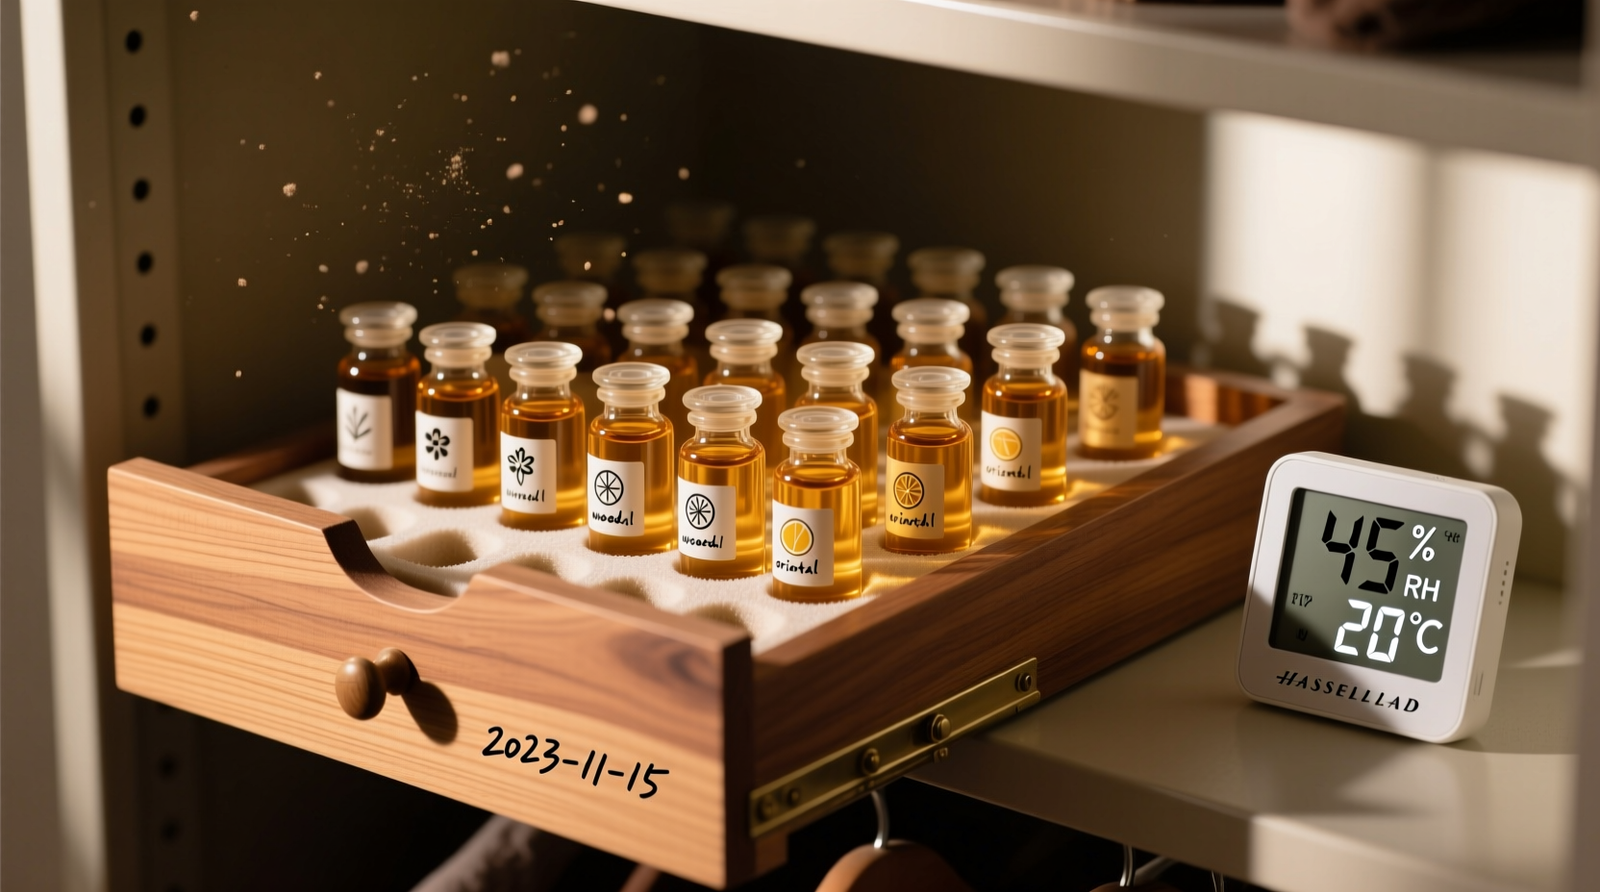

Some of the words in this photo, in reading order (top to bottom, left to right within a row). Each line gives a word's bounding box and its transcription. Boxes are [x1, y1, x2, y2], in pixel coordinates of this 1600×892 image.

[1404, 574, 1441, 602] RH
[1276, 670, 1420, 713] HASSELLLAD
[481, 726, 670, 799] 2023-11-15
